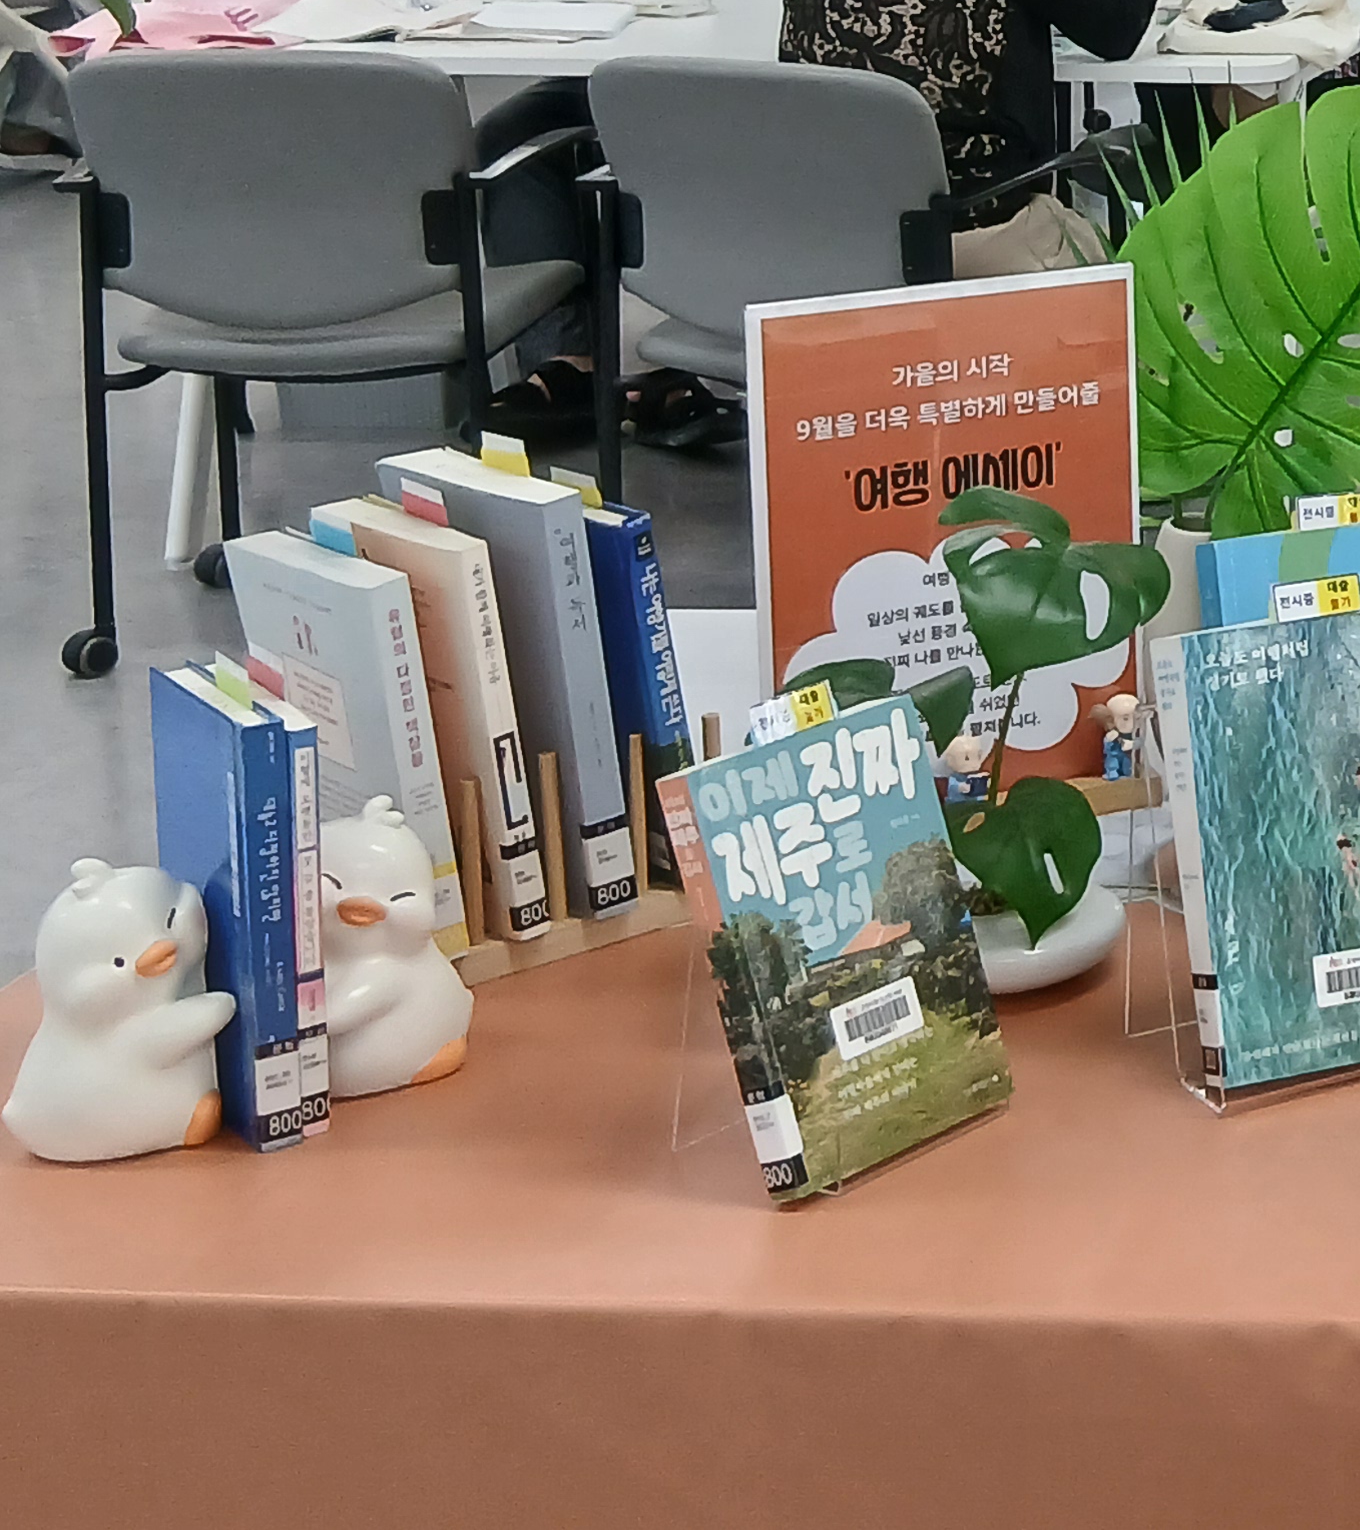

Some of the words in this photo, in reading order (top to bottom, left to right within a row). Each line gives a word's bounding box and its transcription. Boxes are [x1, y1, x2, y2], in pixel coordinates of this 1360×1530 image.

[892, 359, 958, 388] 가을의
[966, 353, 1014, 378] 시작
[796, 413, 857, 442] 9월을
[865, 406, 911, 432] 더욱
[917, 393, 1006, 426] 특별하게
[1014, 381, 1100, 415] 만들어줄
[845, 460, 929, 512] '여행
[699, 750, 799, 821] 이제
[800, 708, 920, 823] 진짜
[597, 879, 631, 906] 800
[789, 871, 873, 950] 갑서
[269, 1110, 302, 1136] 800
[302, 1097, 331, 1121] 80
[763, 1162, 793, 1188] 800
